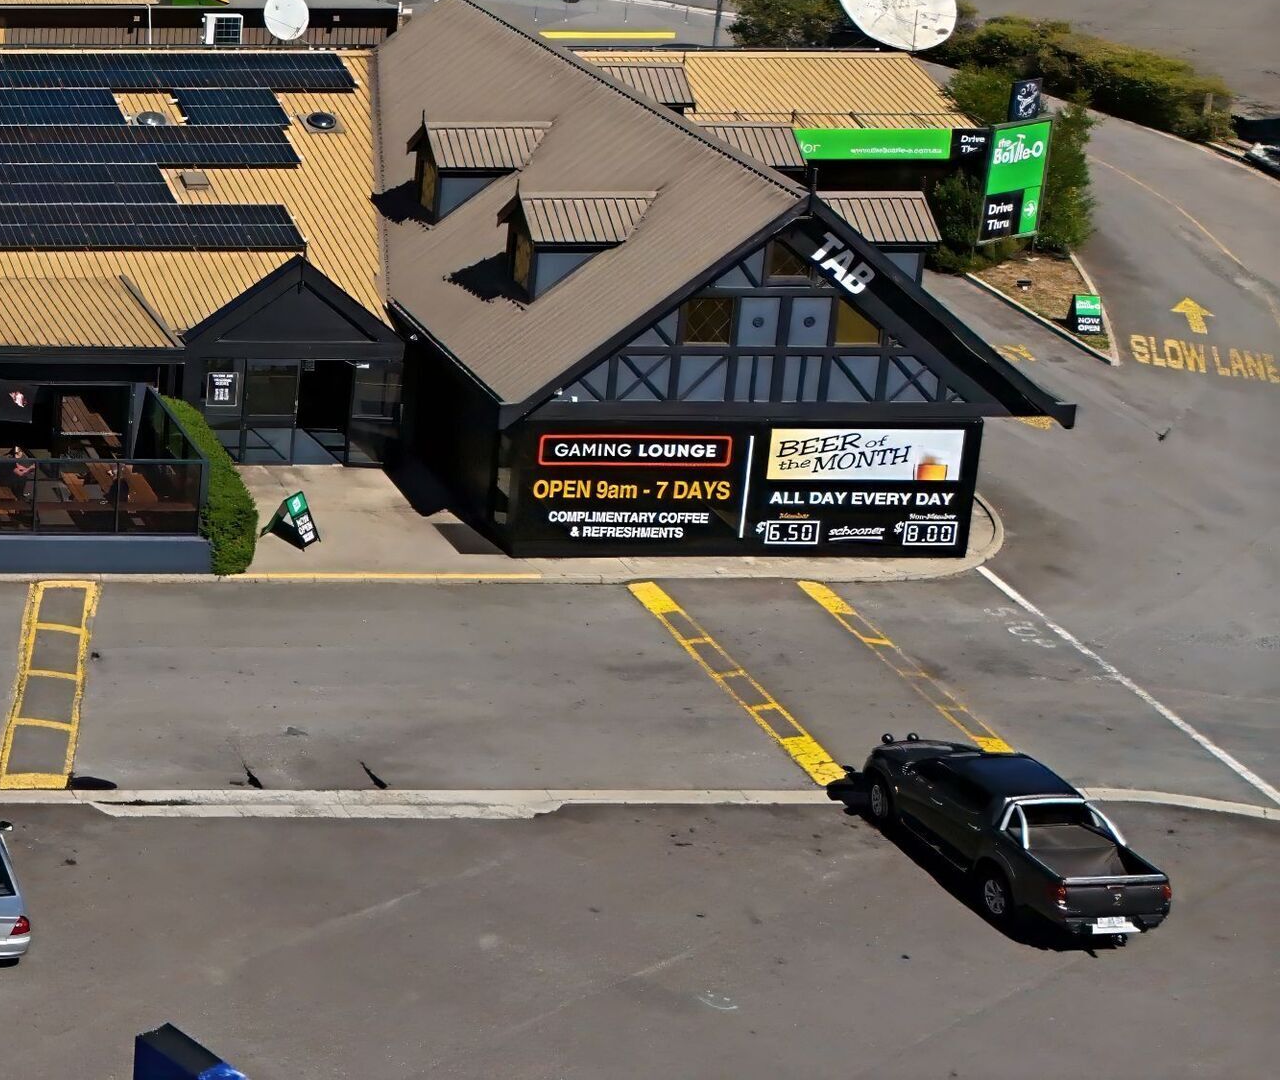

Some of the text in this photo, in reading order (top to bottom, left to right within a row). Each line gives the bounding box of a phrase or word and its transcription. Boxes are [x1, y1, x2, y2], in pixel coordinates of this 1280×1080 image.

[960, 134, 986, 143] Drive
[998, 137, 1012, 149] the
[988, 201, 1014, 216] Drive
[987, 218, 1010, 231] Thru
[811, 231, 876, 295] TAB
[1078, 324, 1101, 332] OPEN
[1130, 334, 1280, 384] SLOW LANE
[554, 443, 717, 458] GAMING LOUNGE
[776, 433, 889, 458] BEER of
[778, 445, 912, 474] the MONTH
[533, 479, 592, 499] OPEN
[595, 480, 638, 499] 9am
[655, 480, 669, 499] 7
[672, 480, 732, 500] DAYS
[769, 491, 955, 506] ALL DAY EVERY DAY
[548, 510, 710, 524] COMPLIMENTARY COFFEE
[569, 525, 684, 539] & REFRESHMENTS
[827, 524, 886, 536] schooner
